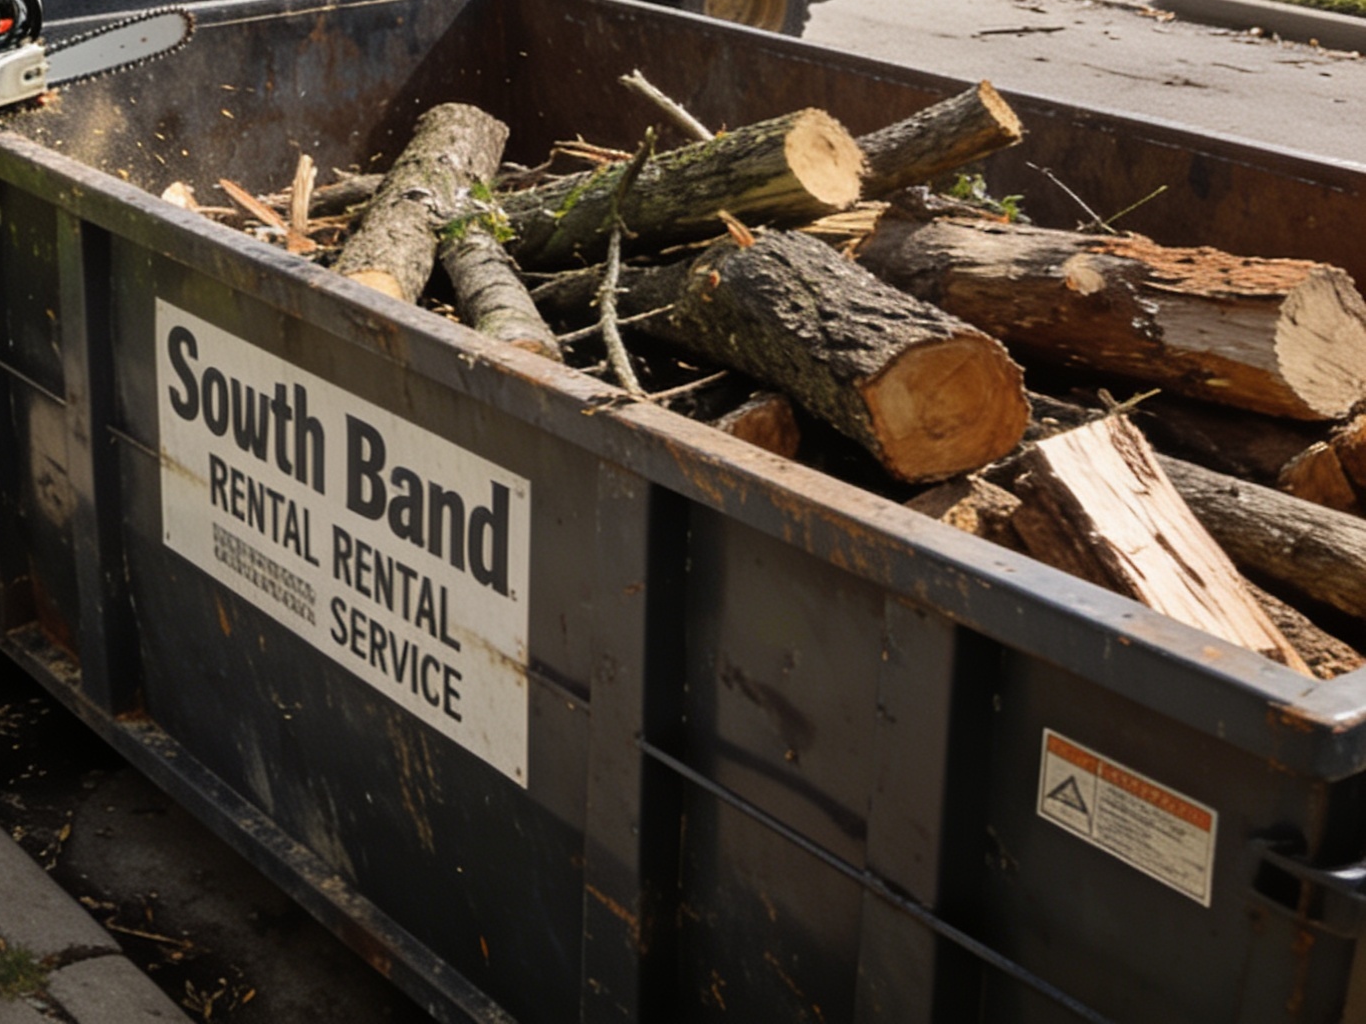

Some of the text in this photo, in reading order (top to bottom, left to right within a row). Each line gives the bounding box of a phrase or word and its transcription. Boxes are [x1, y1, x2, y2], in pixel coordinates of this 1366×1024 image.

[209, 452, 320, 568] RENTAL
[332, 524, 461, 652] RENTAL
[346, 413, 509, 597] Band
[330, 596, 463, 723] SERVICE
